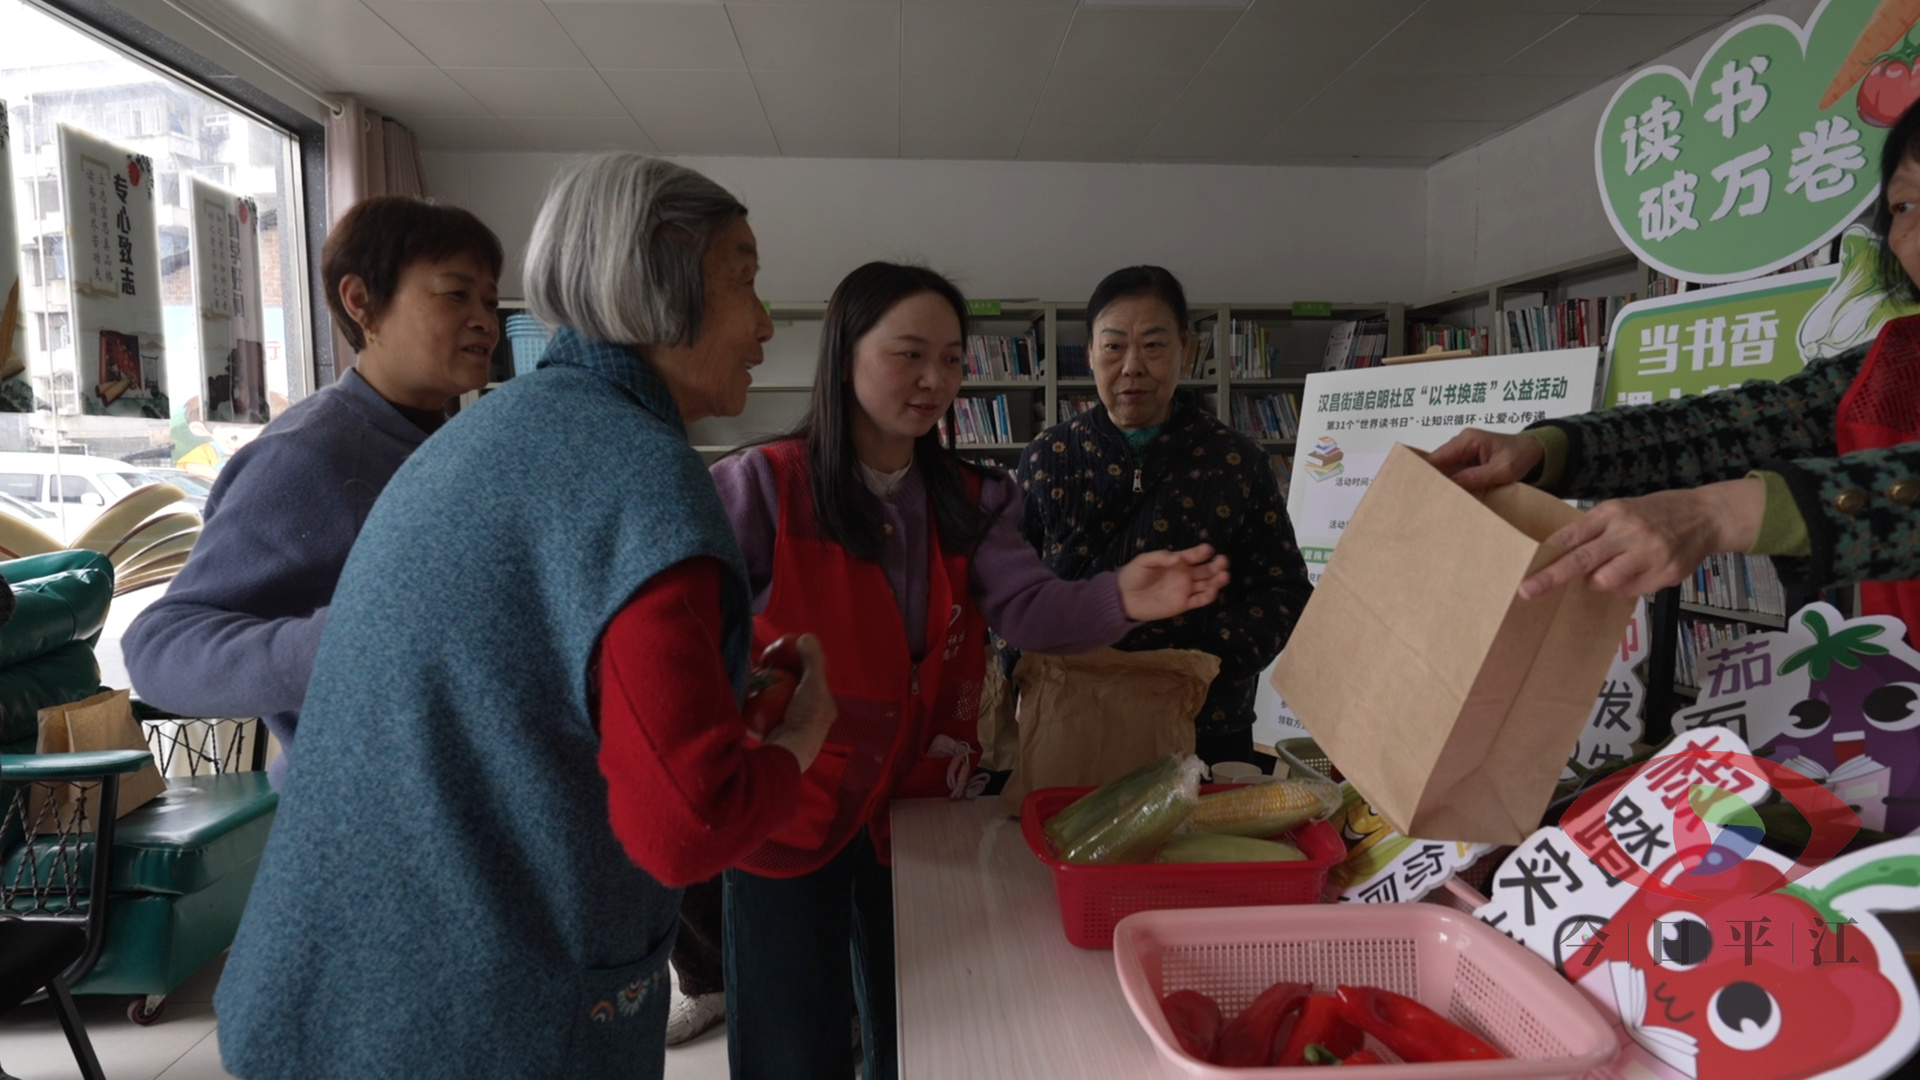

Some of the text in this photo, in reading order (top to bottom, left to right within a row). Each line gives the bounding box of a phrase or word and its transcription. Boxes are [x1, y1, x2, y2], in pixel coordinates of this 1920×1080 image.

[1620, 55, 1771, 176] 读书
[113, 173, 136, 296] 专心致志
[1638, 116, 1867, 241] 破万卷
[1317, 376, 1569, 413] 汉昌街道启明社区“以书换蔬”公益活动
[1638, 310, 1779, 376] 当书香
[1328, 519, 1350, 531] 活动
[1478, 735, 1756, 946] 椒踏实
